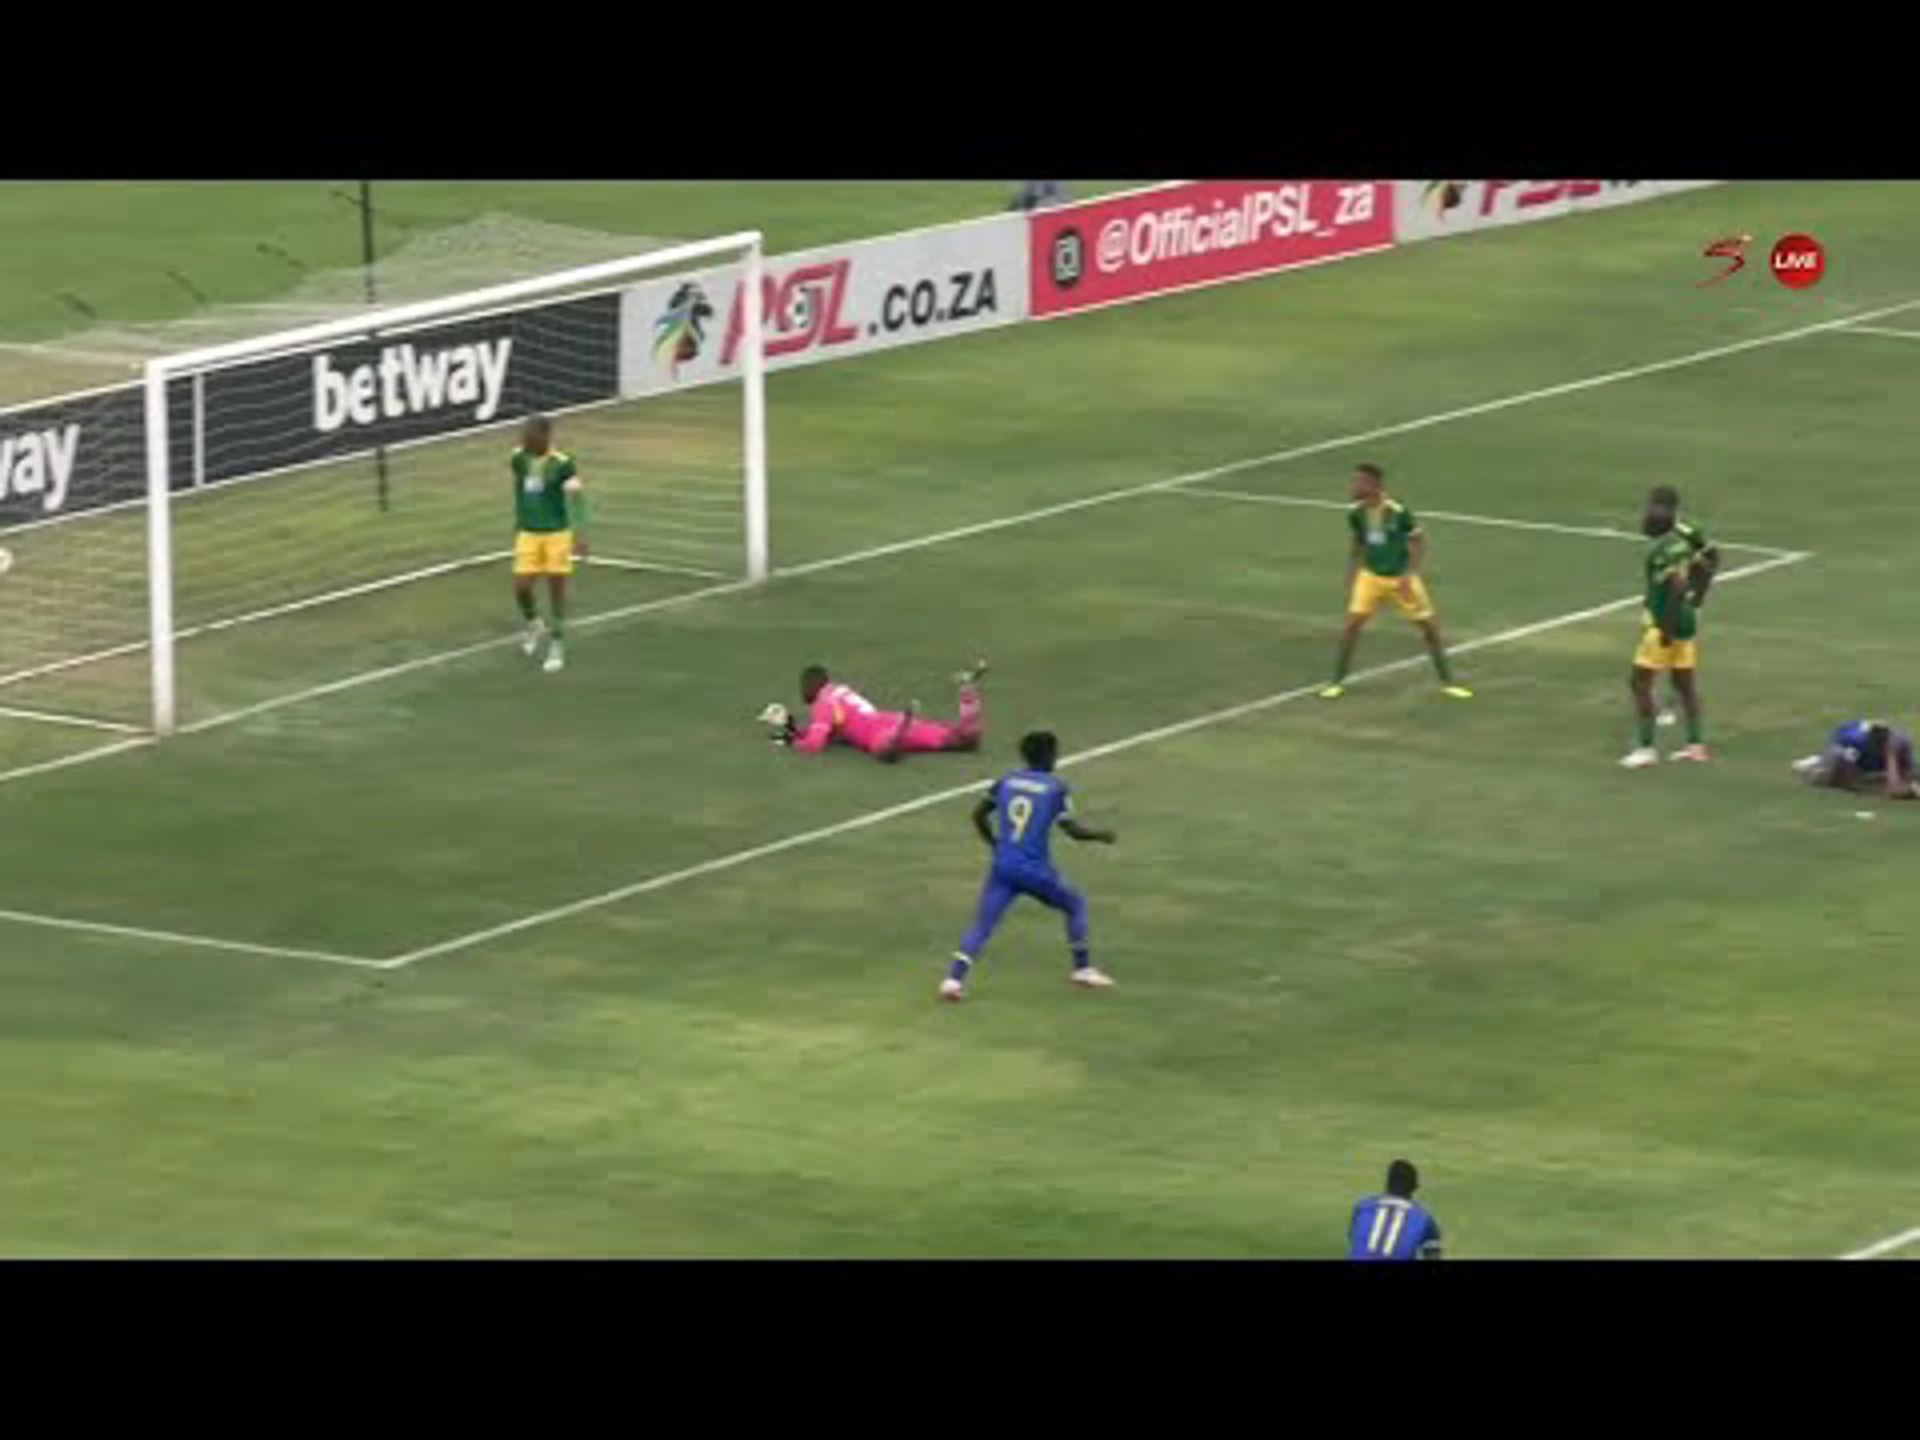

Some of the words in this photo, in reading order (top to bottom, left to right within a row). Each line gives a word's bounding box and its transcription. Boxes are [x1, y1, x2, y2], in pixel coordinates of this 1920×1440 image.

[313, 338, 513, 432] betway
[0, 423, 80, 510] ay
[1008, 796, 1033, 842] 9
[1367, 1206, 1405, 1257] 11
